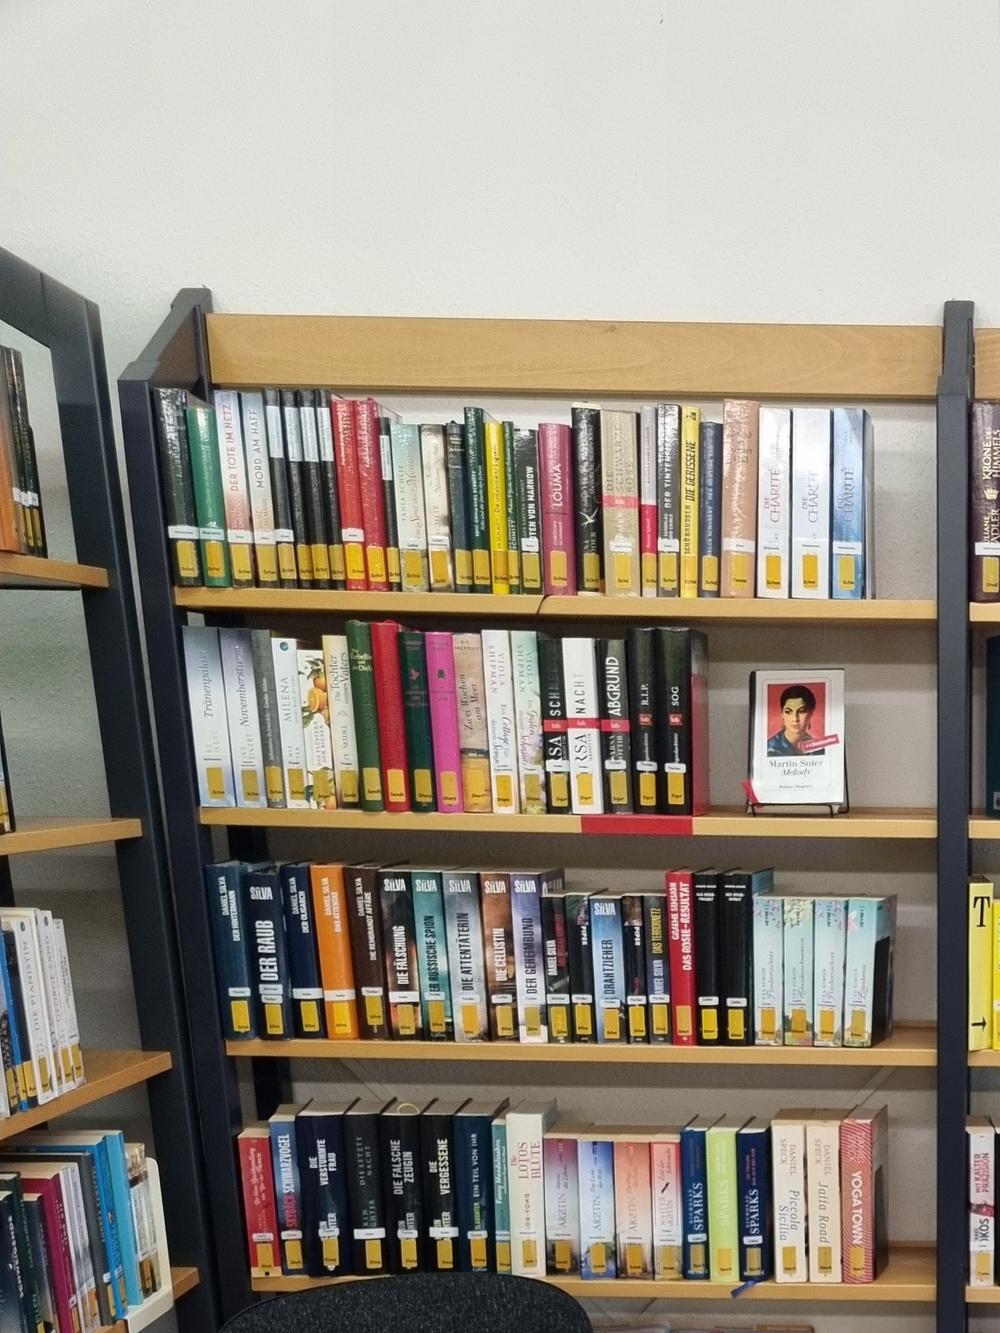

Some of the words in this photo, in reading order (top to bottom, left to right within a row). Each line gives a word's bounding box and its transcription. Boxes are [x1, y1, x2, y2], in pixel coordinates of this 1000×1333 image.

[606, 656, 622, 716] ABGRUND
[769, 760, 797, 768] Martin
[973, 896, 990, 927] T
[256, 919, 274, 954] RAUB
[260, 956, 278, 981] DER
[397, 968, 409, 984] DIE
[683, 957, 692, 971] DAS
[462, 974, 474, 991] DIE
[526, 974, 538, 994] DER
[328, 1152, 336, 1172] FRAU
[390, 1140, 402, 1172] FALSCHE
[403, 1151, 415, 1183] ZEUGIN
[429, 1160, 437, 1173] DIE
[437, 1138, 450, 1195] VERGESSENE
[393, 1174, 403, 1195] DIE
[694, 1183, 703, 1231] SPARKS
[750, 1188, 760, 1235] SPARKS
